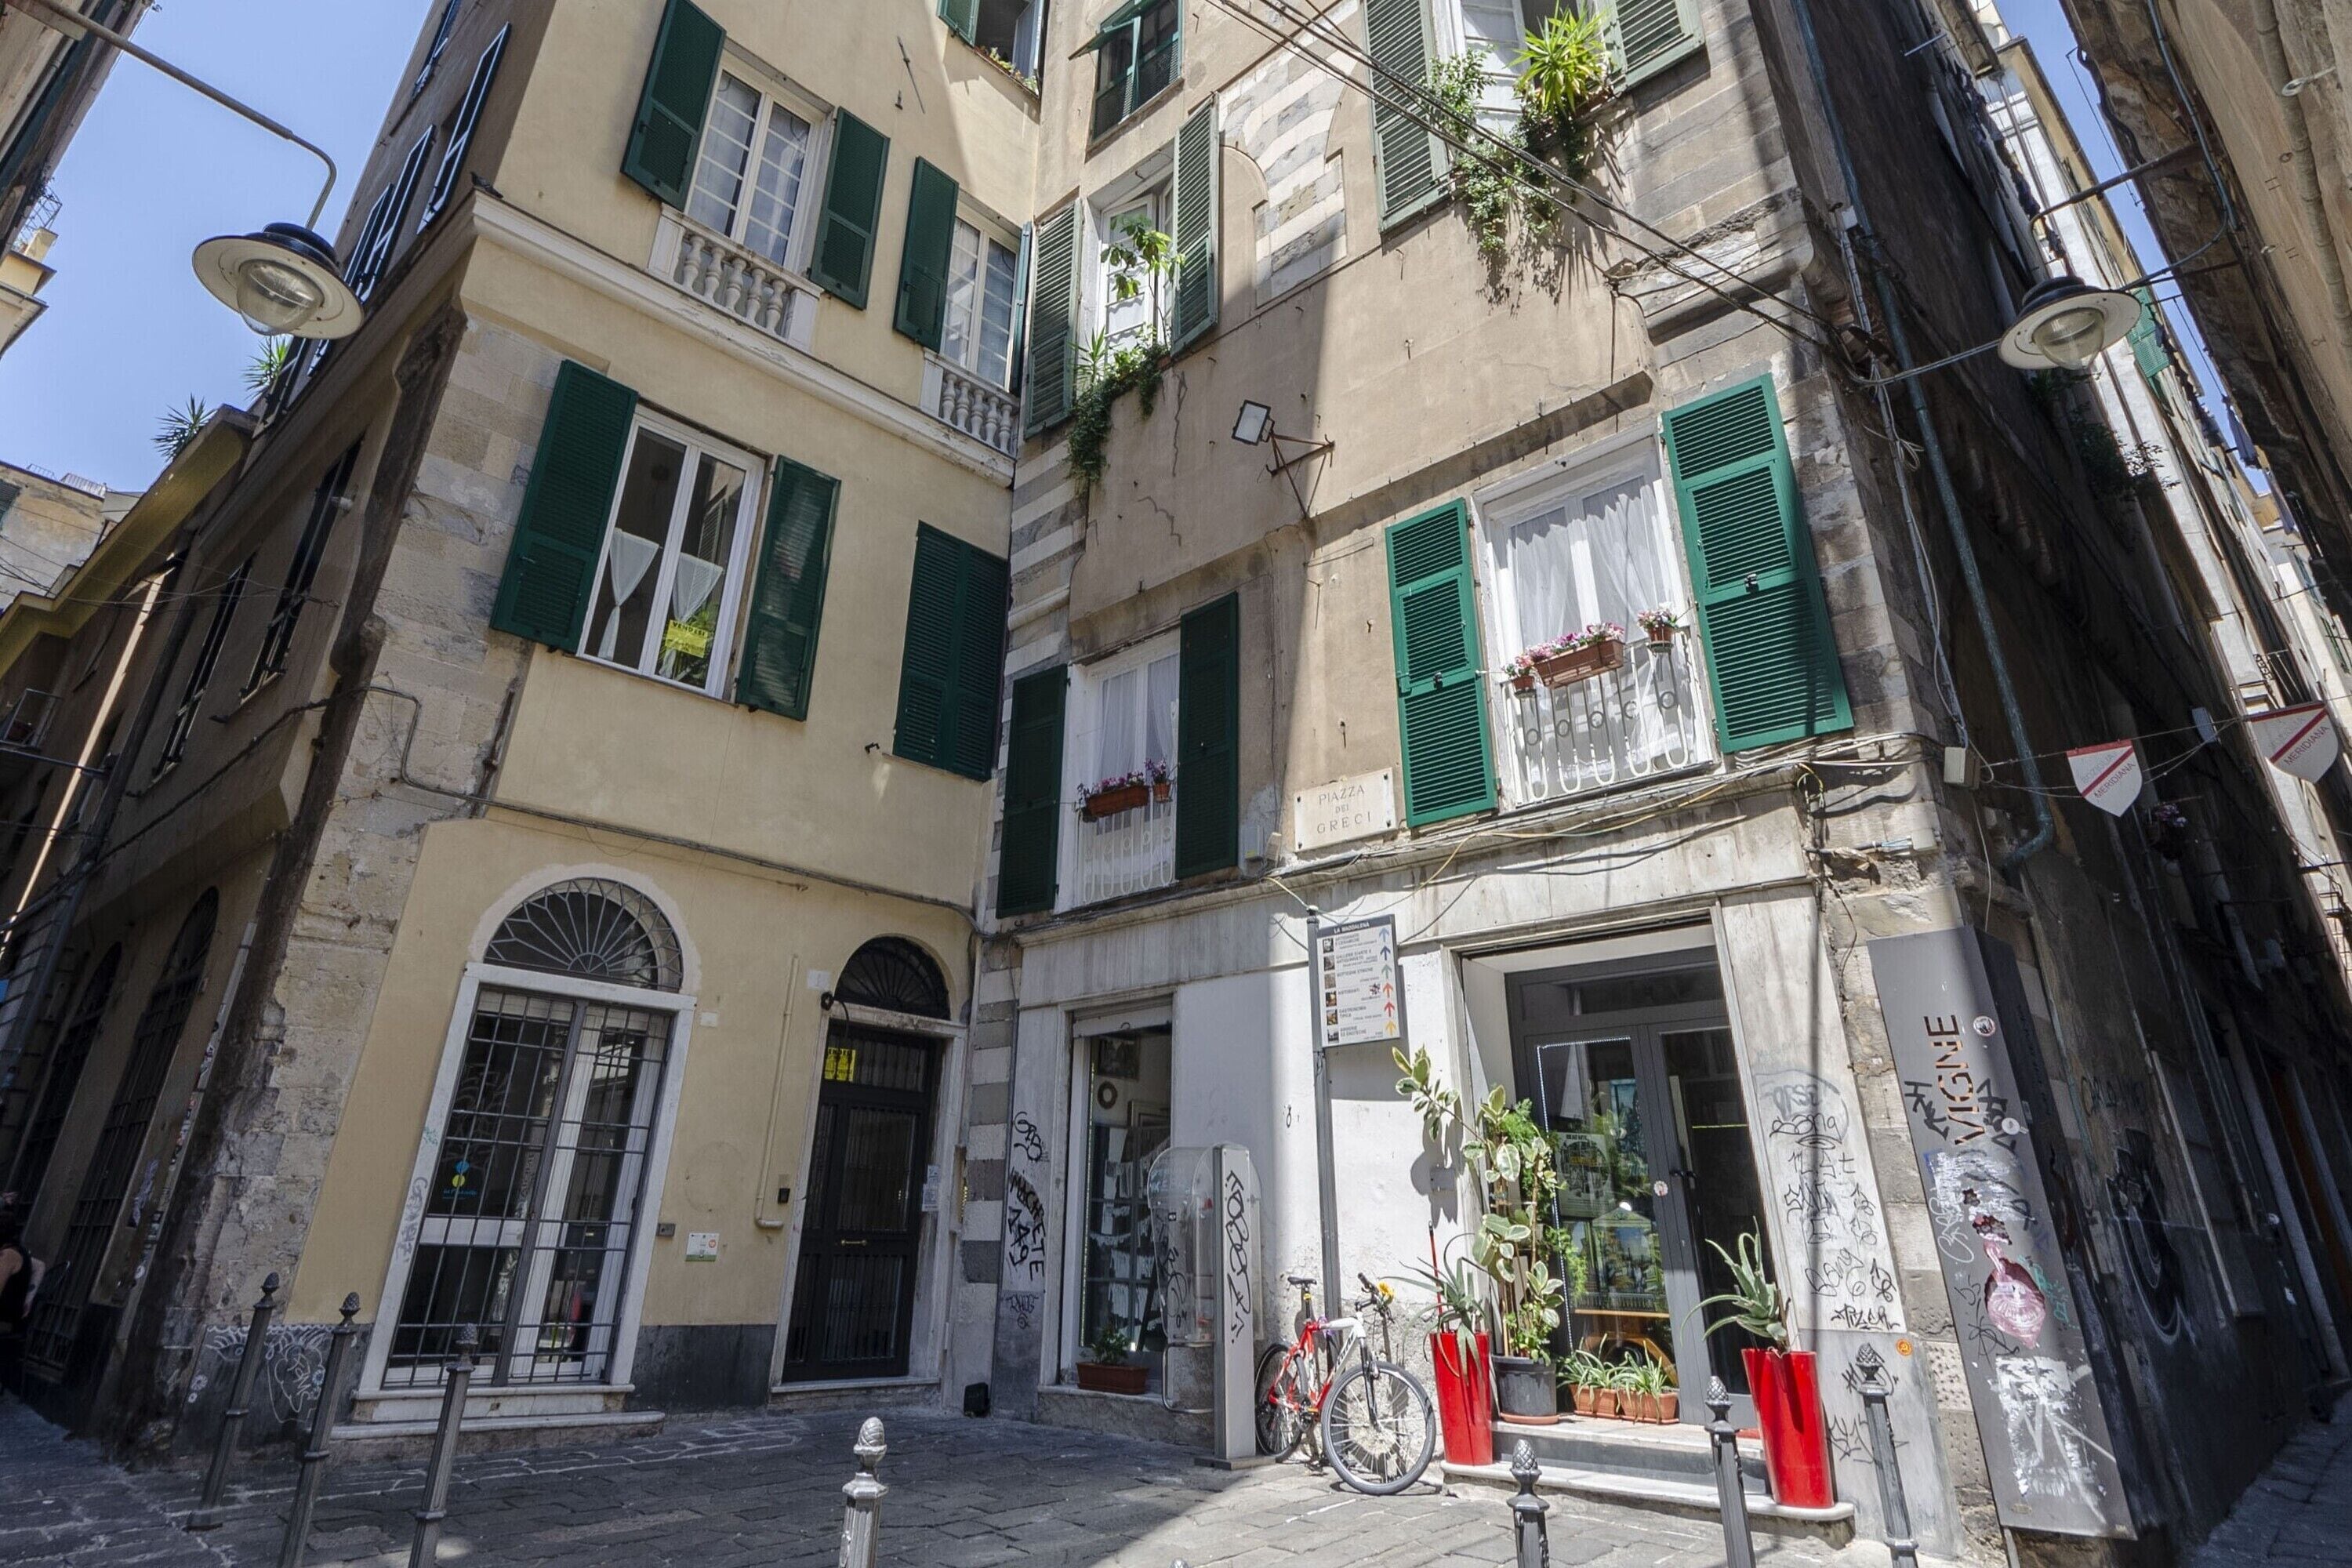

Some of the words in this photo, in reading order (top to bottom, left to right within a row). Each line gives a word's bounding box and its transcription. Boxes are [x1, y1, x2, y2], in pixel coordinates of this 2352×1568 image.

[673, 622, 705, 636] VENDESI
[2284, 726, 2331, 765] MERIDIANA
[2094, 761, 2136, 797] MERIDIANA
[1319, 785, 1365, 805] PIAZZA
[1335, 804, 1349, 814] DEI
[1317, 811, 1371, 833] GRECI
[1341, 921, 1370, 932] MADDALENA
[1924, 1014, 1985, 1145] VIGNE
